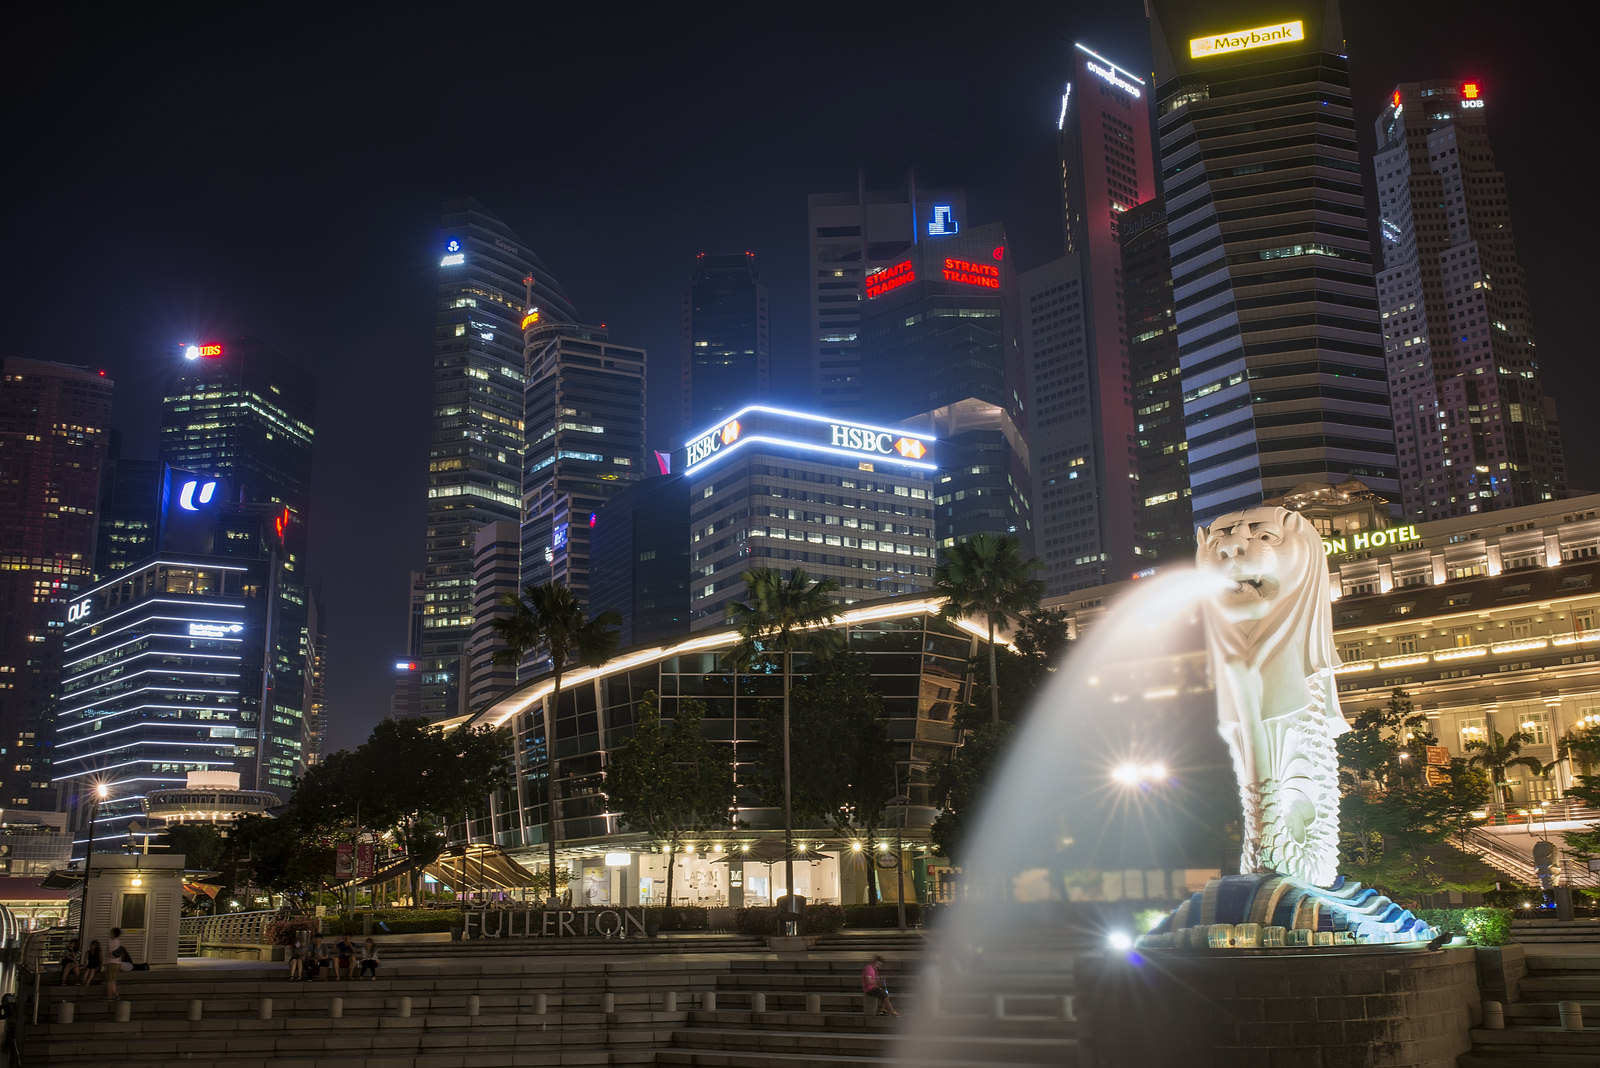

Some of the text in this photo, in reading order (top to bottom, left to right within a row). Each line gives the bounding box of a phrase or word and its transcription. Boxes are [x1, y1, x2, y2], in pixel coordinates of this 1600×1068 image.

[1214, 27, 1292, 49] Maybank
[1461, 100, 1484, 108] UOB
[866, 260, 912, 287] STRAITS
[942, 269, 1000, 288] TRADING
[945, 258, 999, 277] STRAITS
[866, 271, 915, 298] TRADING
[199, 345, 221, 356] UBS
[686, 429, 721, 468] HSBC
[830, 424, 893, 454] HSBC
[1353, 525, 1421, 550] HOTEL
[68, 599, 91, 622] OUE
[464, 910, 646, 938] FULLERTON
